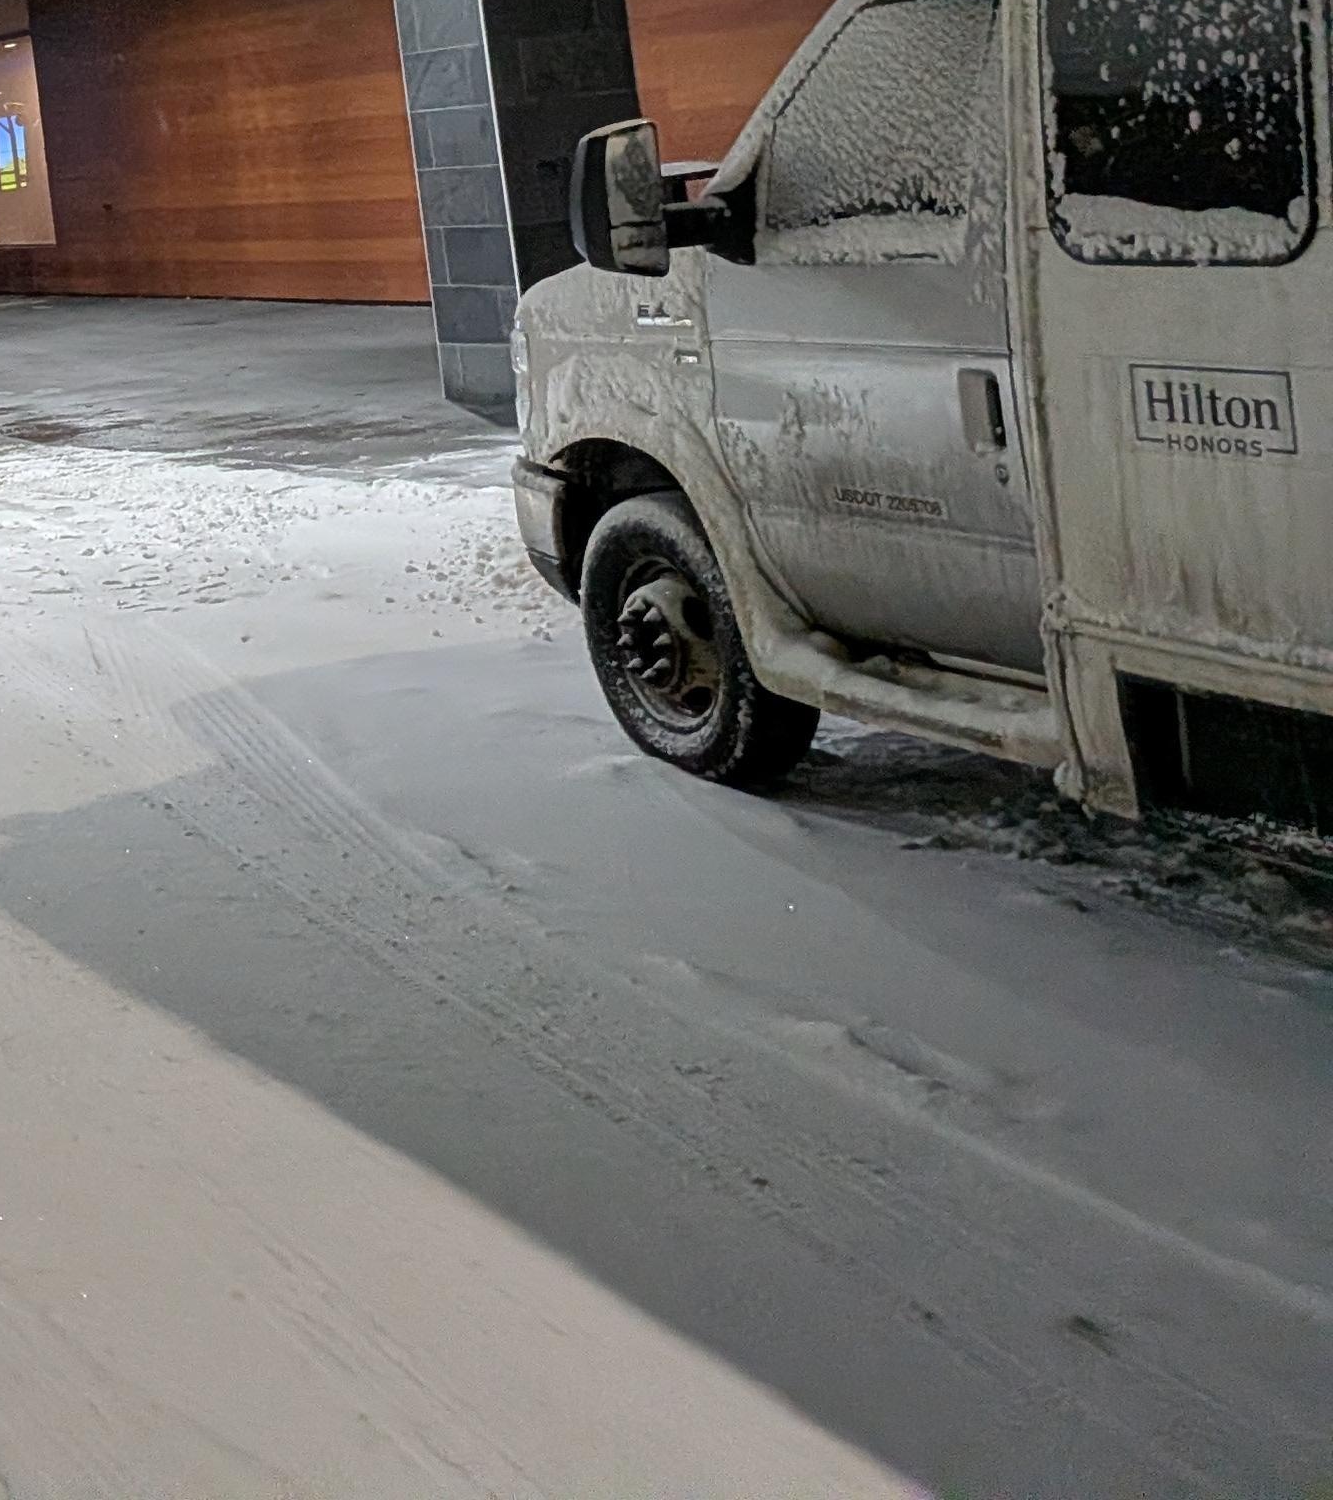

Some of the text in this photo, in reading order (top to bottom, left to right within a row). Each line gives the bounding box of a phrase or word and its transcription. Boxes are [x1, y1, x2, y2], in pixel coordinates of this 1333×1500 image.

[1145, 380, 1280, 431] Hilton
[1168, 435, 1263, 457] HONORS
[835, 486, 882, 508] USDOT
